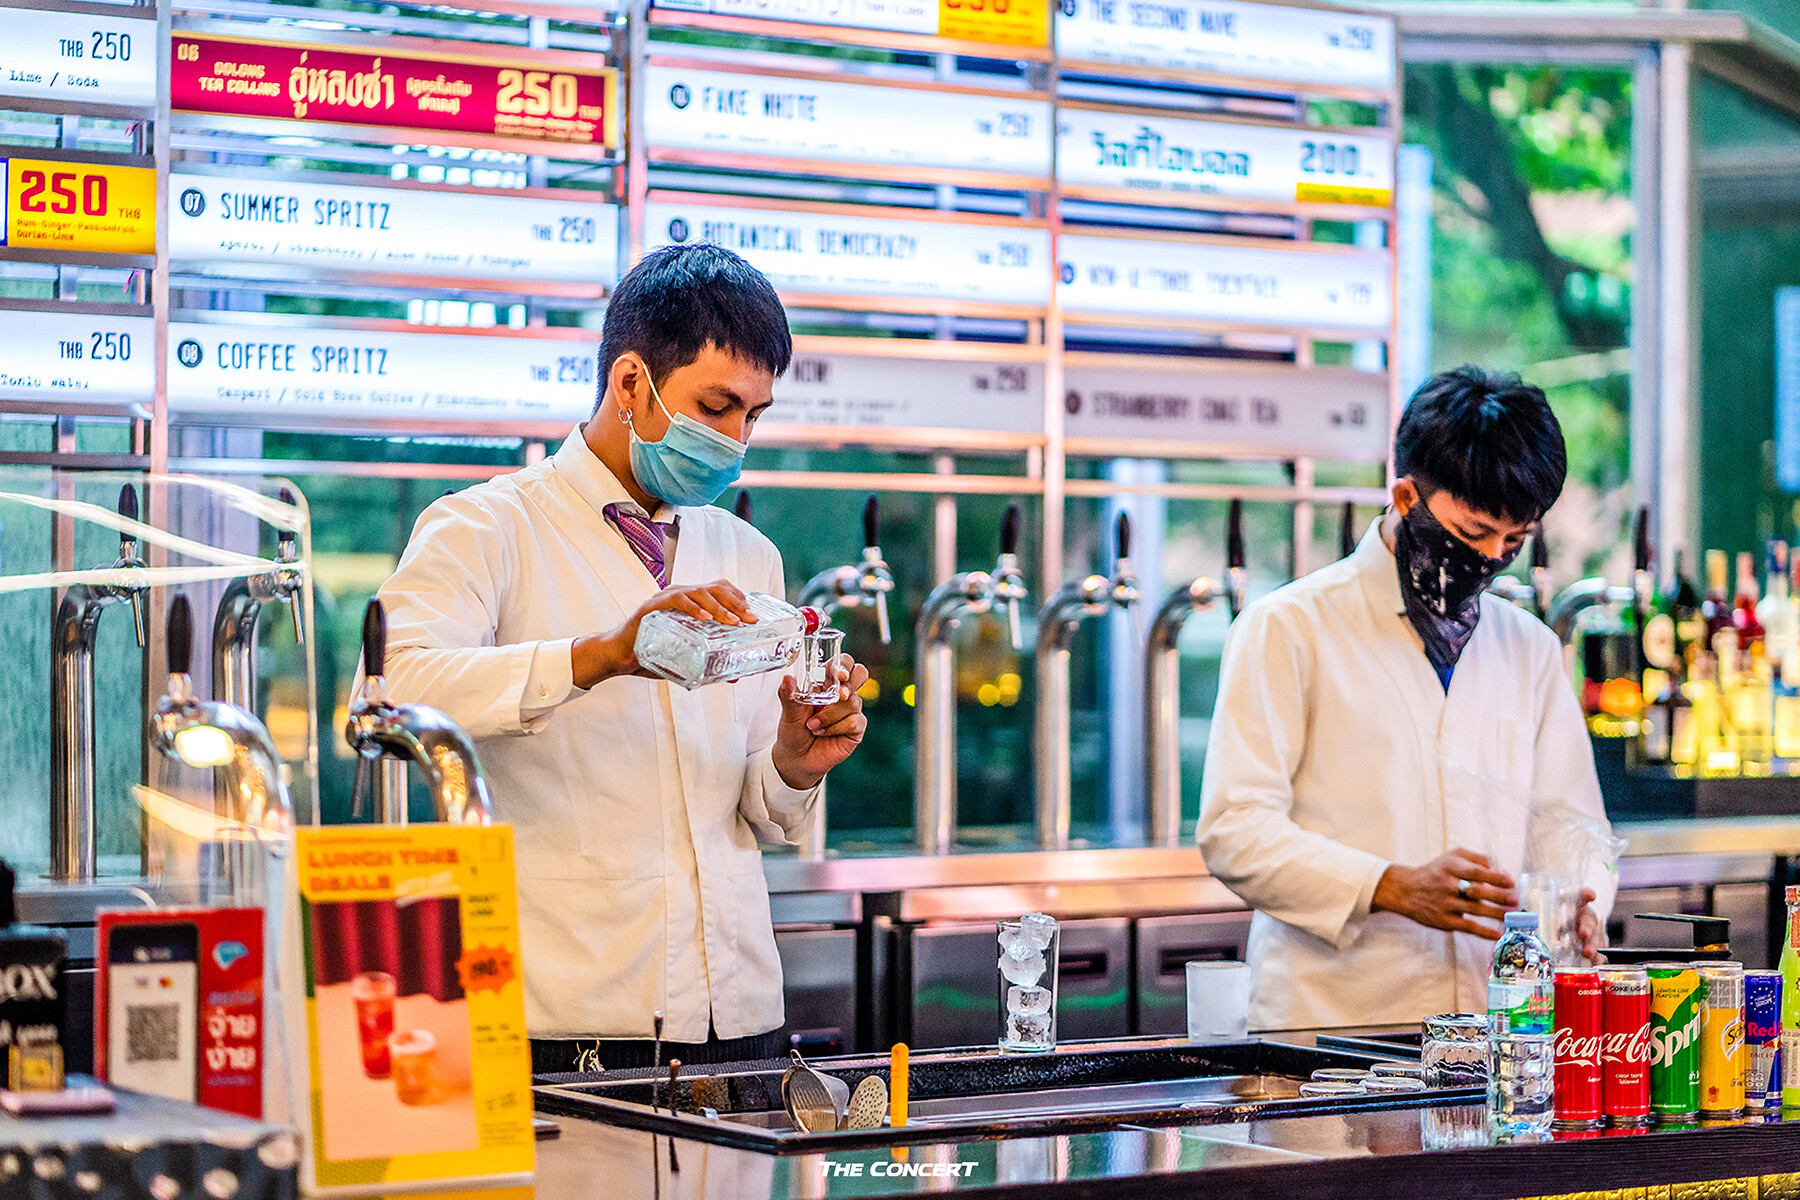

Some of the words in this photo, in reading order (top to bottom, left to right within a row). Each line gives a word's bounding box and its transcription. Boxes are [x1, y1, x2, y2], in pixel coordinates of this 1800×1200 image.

[59, 39, 84, 58] THB
[91, 30, 132, 61] 250
[177, 43, 200, 62] 06
[198, 77, 225, 92] TEA
[496, 69, 579, 118] 250
[20, 169, 108, 217] 250
[118, 207, 141, 220] THB
[184, 193, 201, 213] 07
[220, 191, 300, 224] SUMMER
[314, 197, 391, 230] SPRITZ
[558, 215, 597, 244] 250
[59, 340, 84, 360] THB
[90, 331, 132, 361] 250
[217, 342, 297, 372] COFFEE
[312, 345, 389, 375] SPRITZ
[557, 355, 594, 384] 250
[0, 963, 58, 1001] OX
[1748, 1021, 1778, 1037] Red
